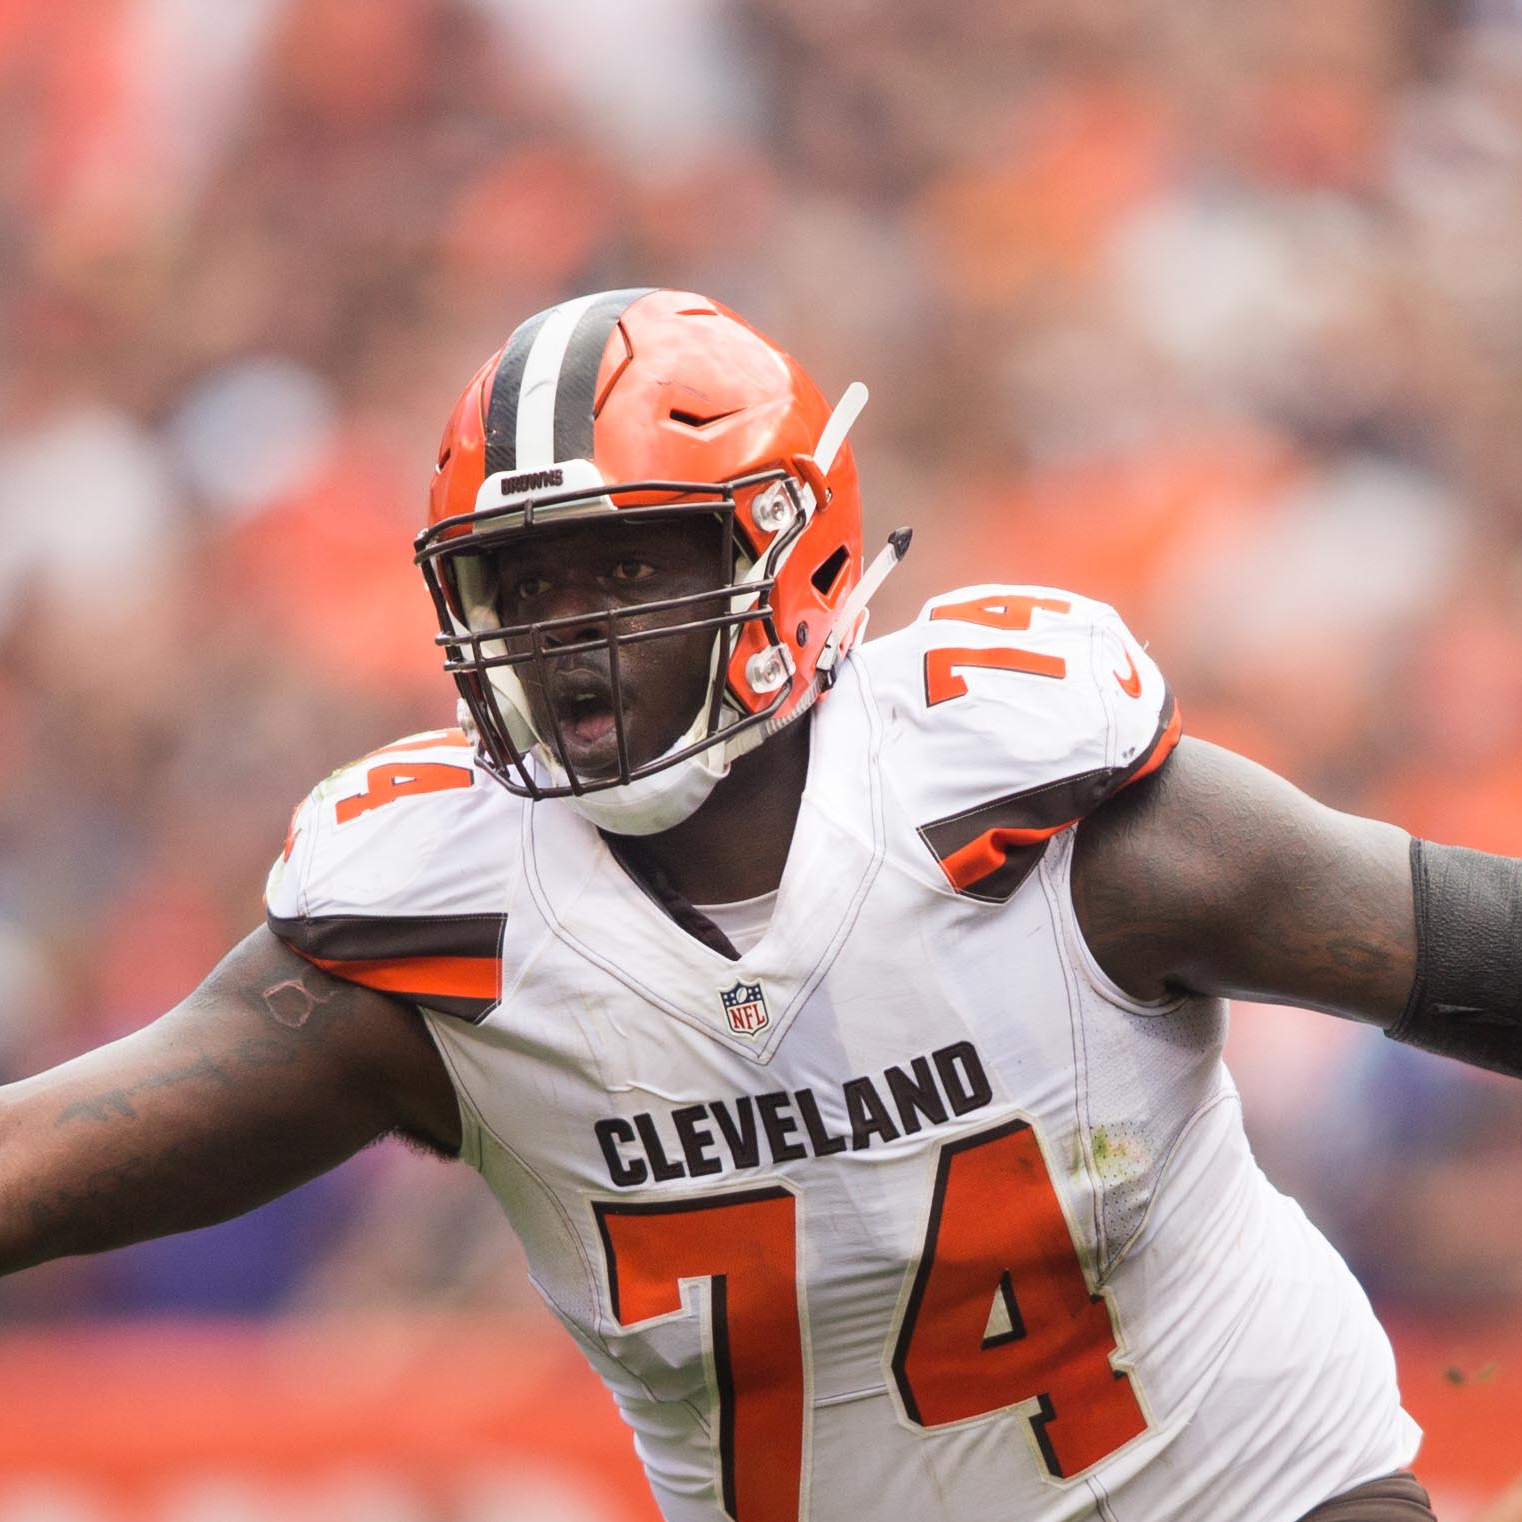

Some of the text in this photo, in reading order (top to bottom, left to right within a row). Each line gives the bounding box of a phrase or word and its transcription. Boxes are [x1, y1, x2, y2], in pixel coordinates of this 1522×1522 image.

[501, 468, 564, 496] BROWNS
[924, 594, 1072, 709] 74
[729, 1004, 766, 1030] NFL
[593, 1040, 993, 1188] CLEVELAND
